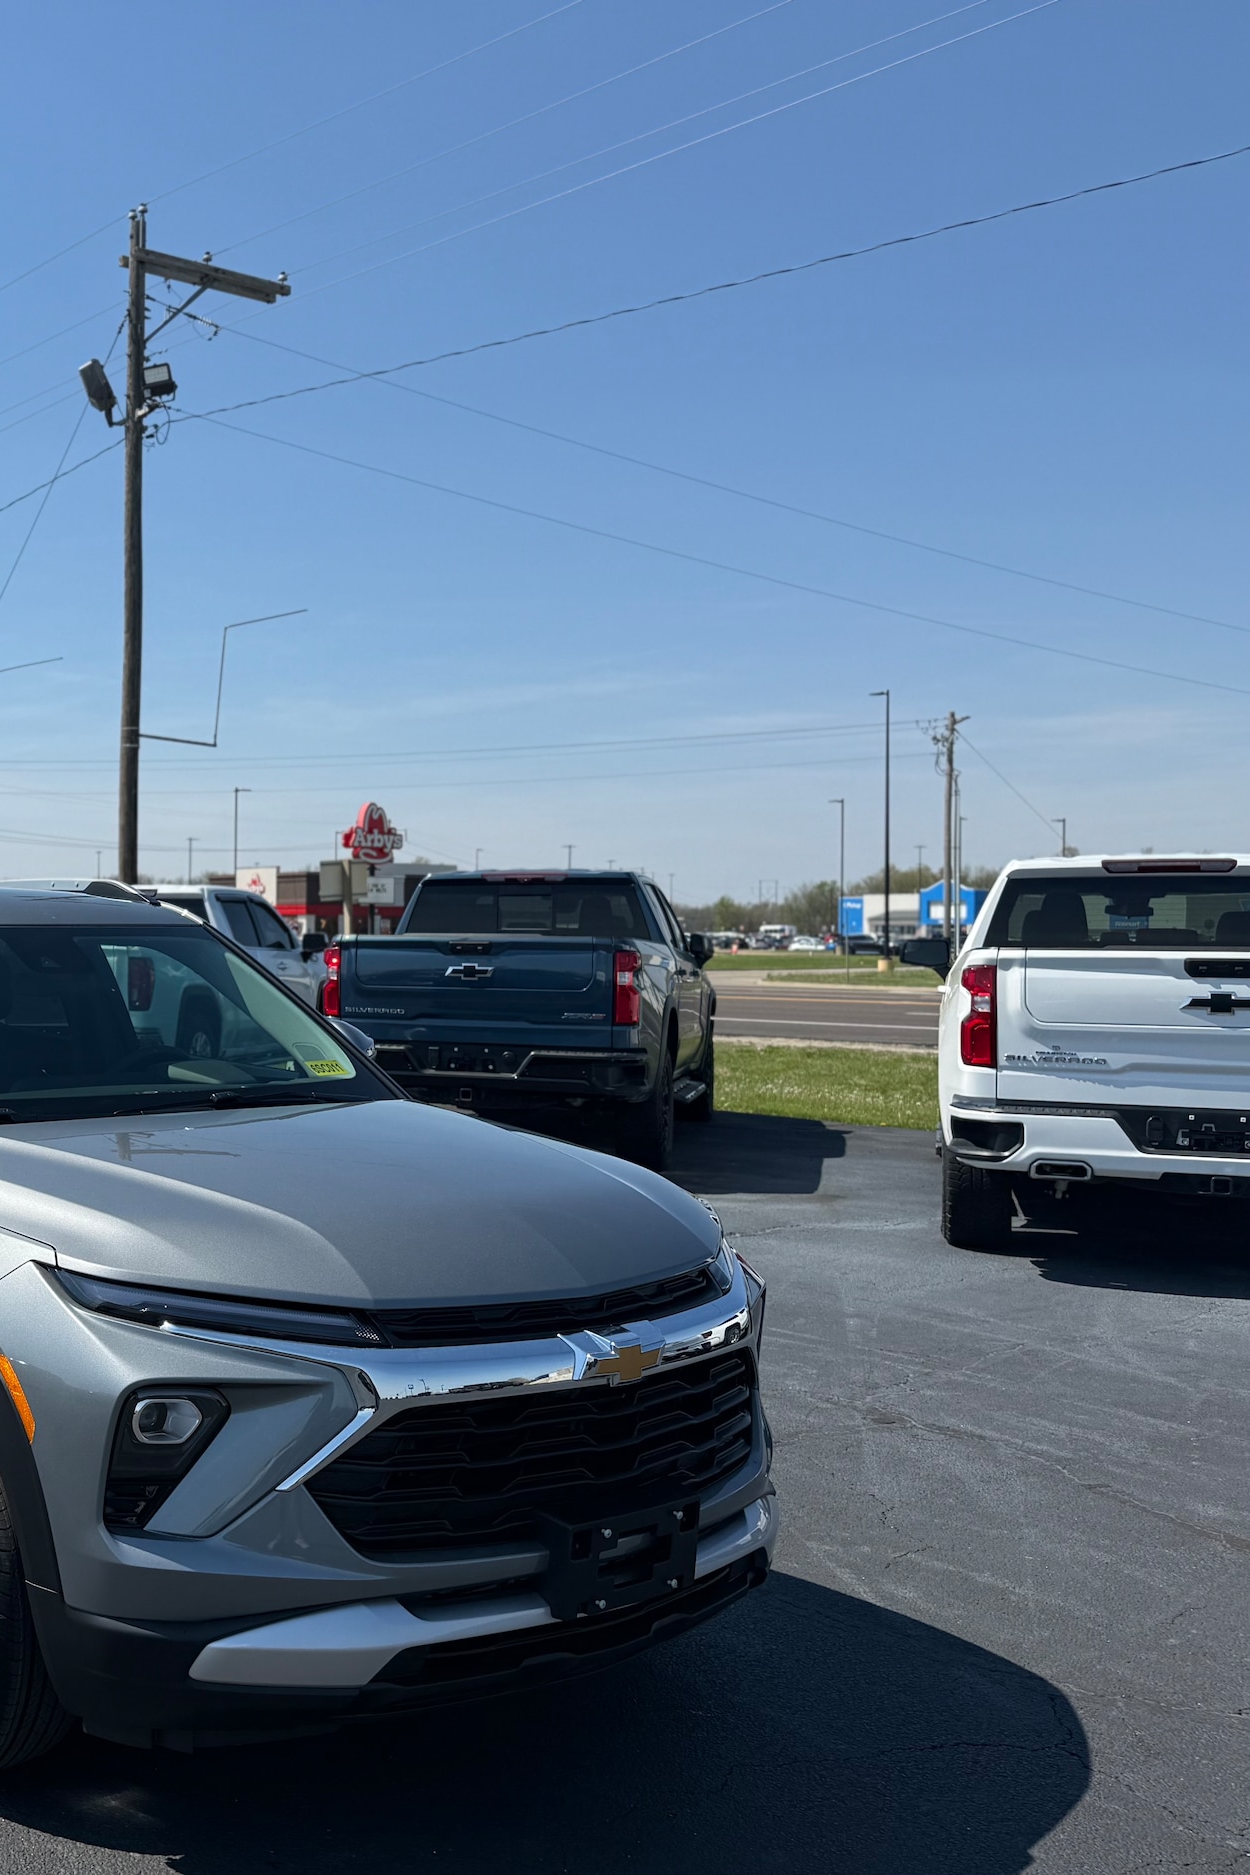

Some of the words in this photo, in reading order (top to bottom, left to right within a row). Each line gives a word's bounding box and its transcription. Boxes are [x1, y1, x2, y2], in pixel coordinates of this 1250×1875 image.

[353, 827, 402, 852] Arby's
[344, 1006, 405, 1015] SILVERADO
[1004, 1053, 1107, 1065] SILVERADO
